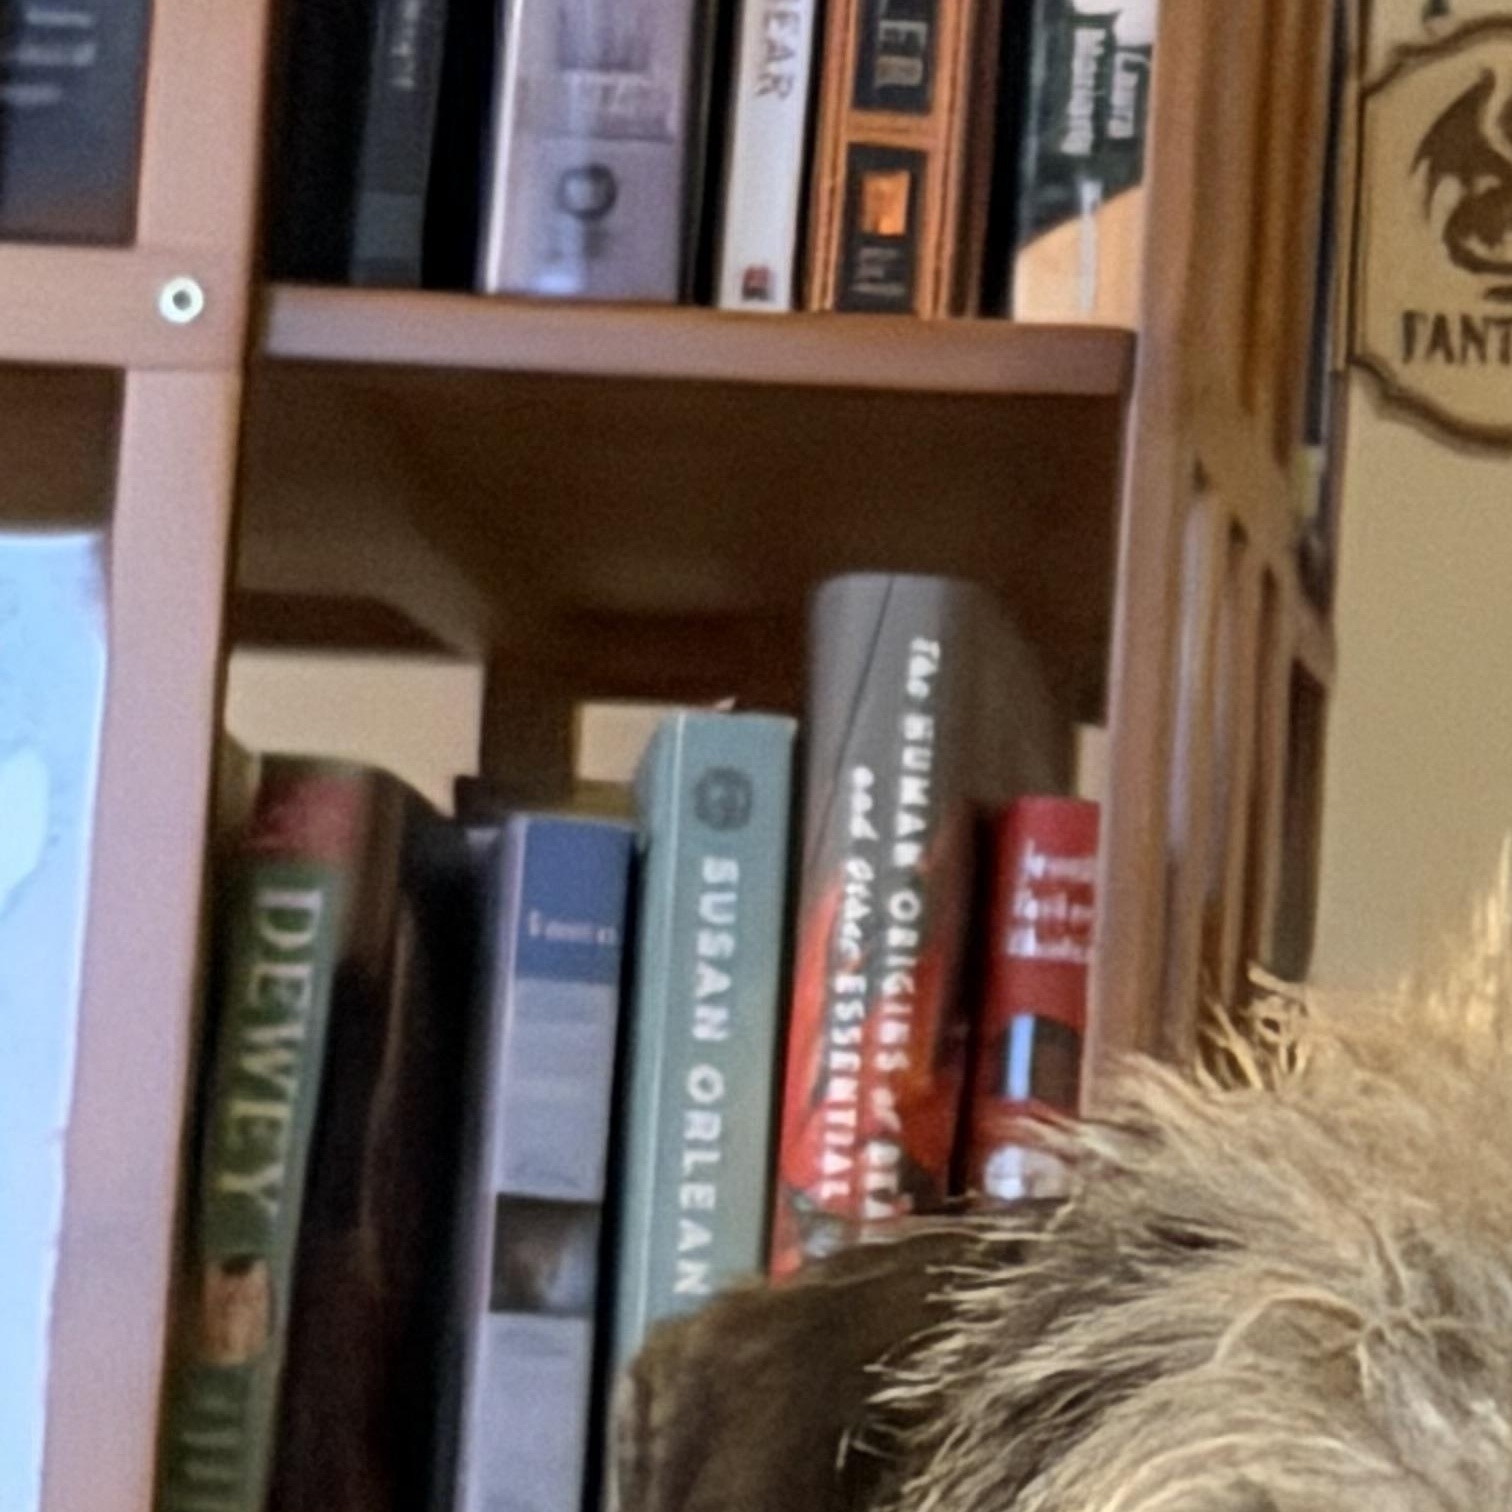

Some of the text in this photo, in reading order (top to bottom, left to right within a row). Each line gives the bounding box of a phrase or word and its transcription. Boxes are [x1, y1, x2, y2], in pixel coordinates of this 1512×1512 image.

[873, 0, 928, 89] ER
[906, 637, 941, 700] The
[892, 713, 935, 868] HUMAN
[216, 888, 324, 1218] DEWEY
[873, 887, 922, 1073] ORIGINS
[673, 855, 739, 1295] SUSAN ORLEAN
[820, 973, 868, 1200] ESSENTIAL
